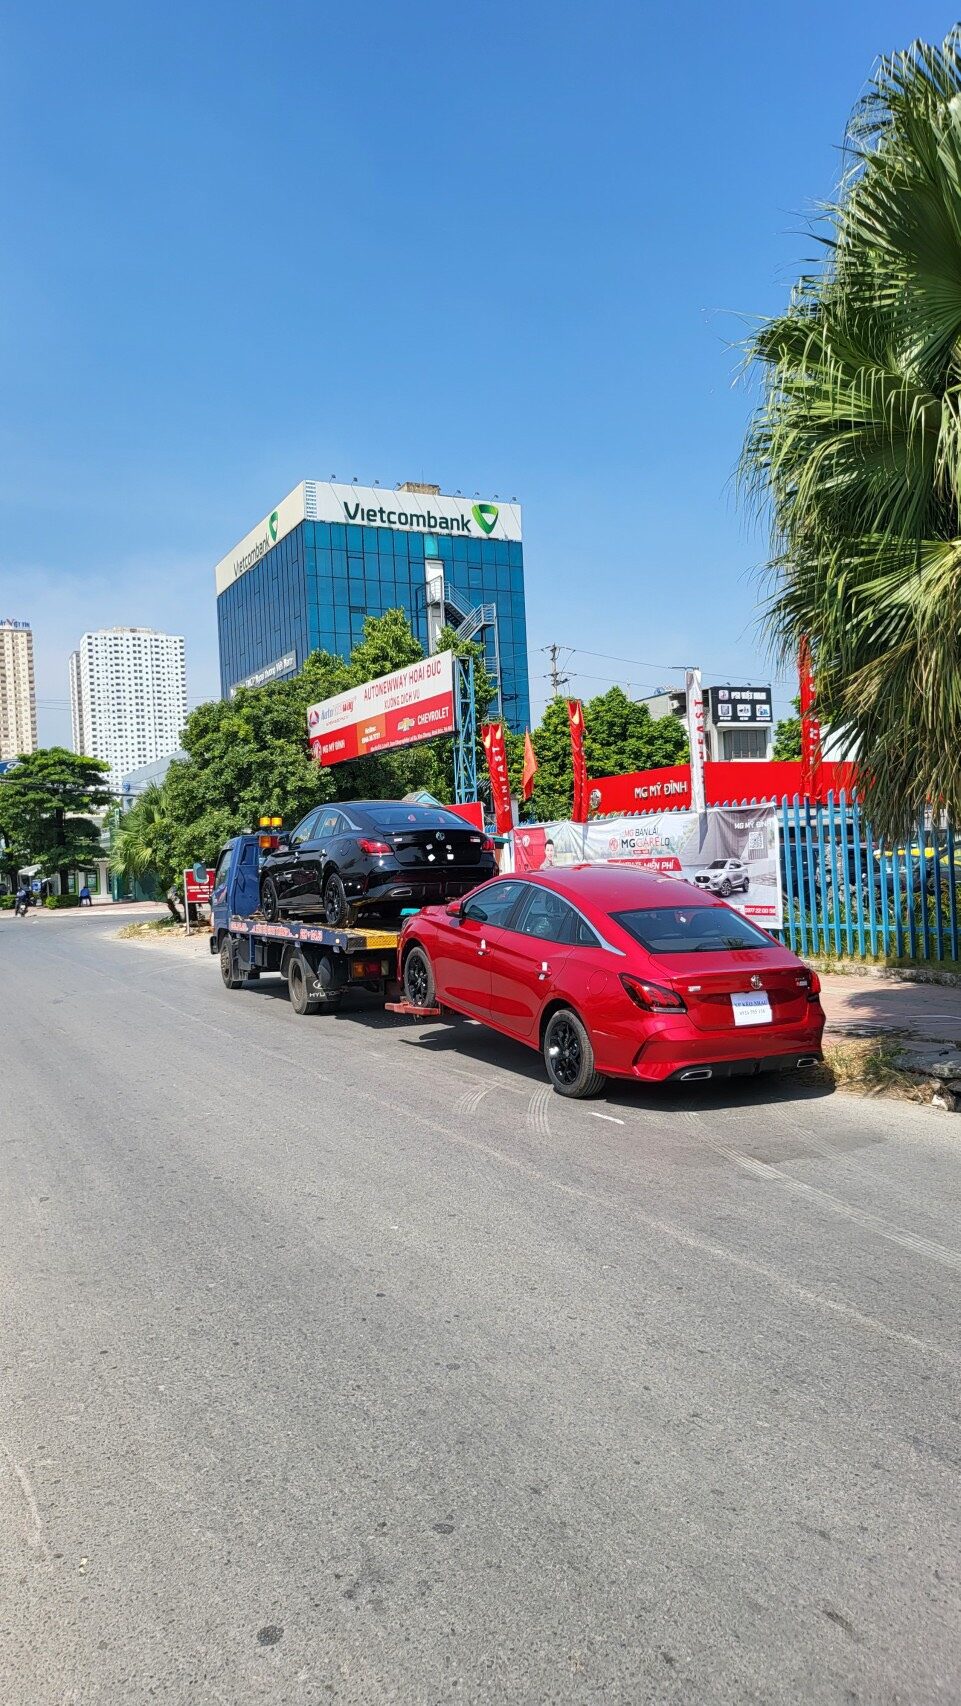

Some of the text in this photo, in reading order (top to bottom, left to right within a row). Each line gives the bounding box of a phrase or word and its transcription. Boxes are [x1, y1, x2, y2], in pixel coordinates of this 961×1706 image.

[344, 501, 472, 533] Vietcombank
[232, 532, 271, 577] Vietcombank
[363, 673, 408, 701] AUTONEWWAY
[417, 706, 449, 725] CHEVROLET
[491, 746, 510, 812] VINFAST
[634, 779, 688, 799] MG MỸ ĐÌNH
[661, 859, 675, 871] PHÍ
